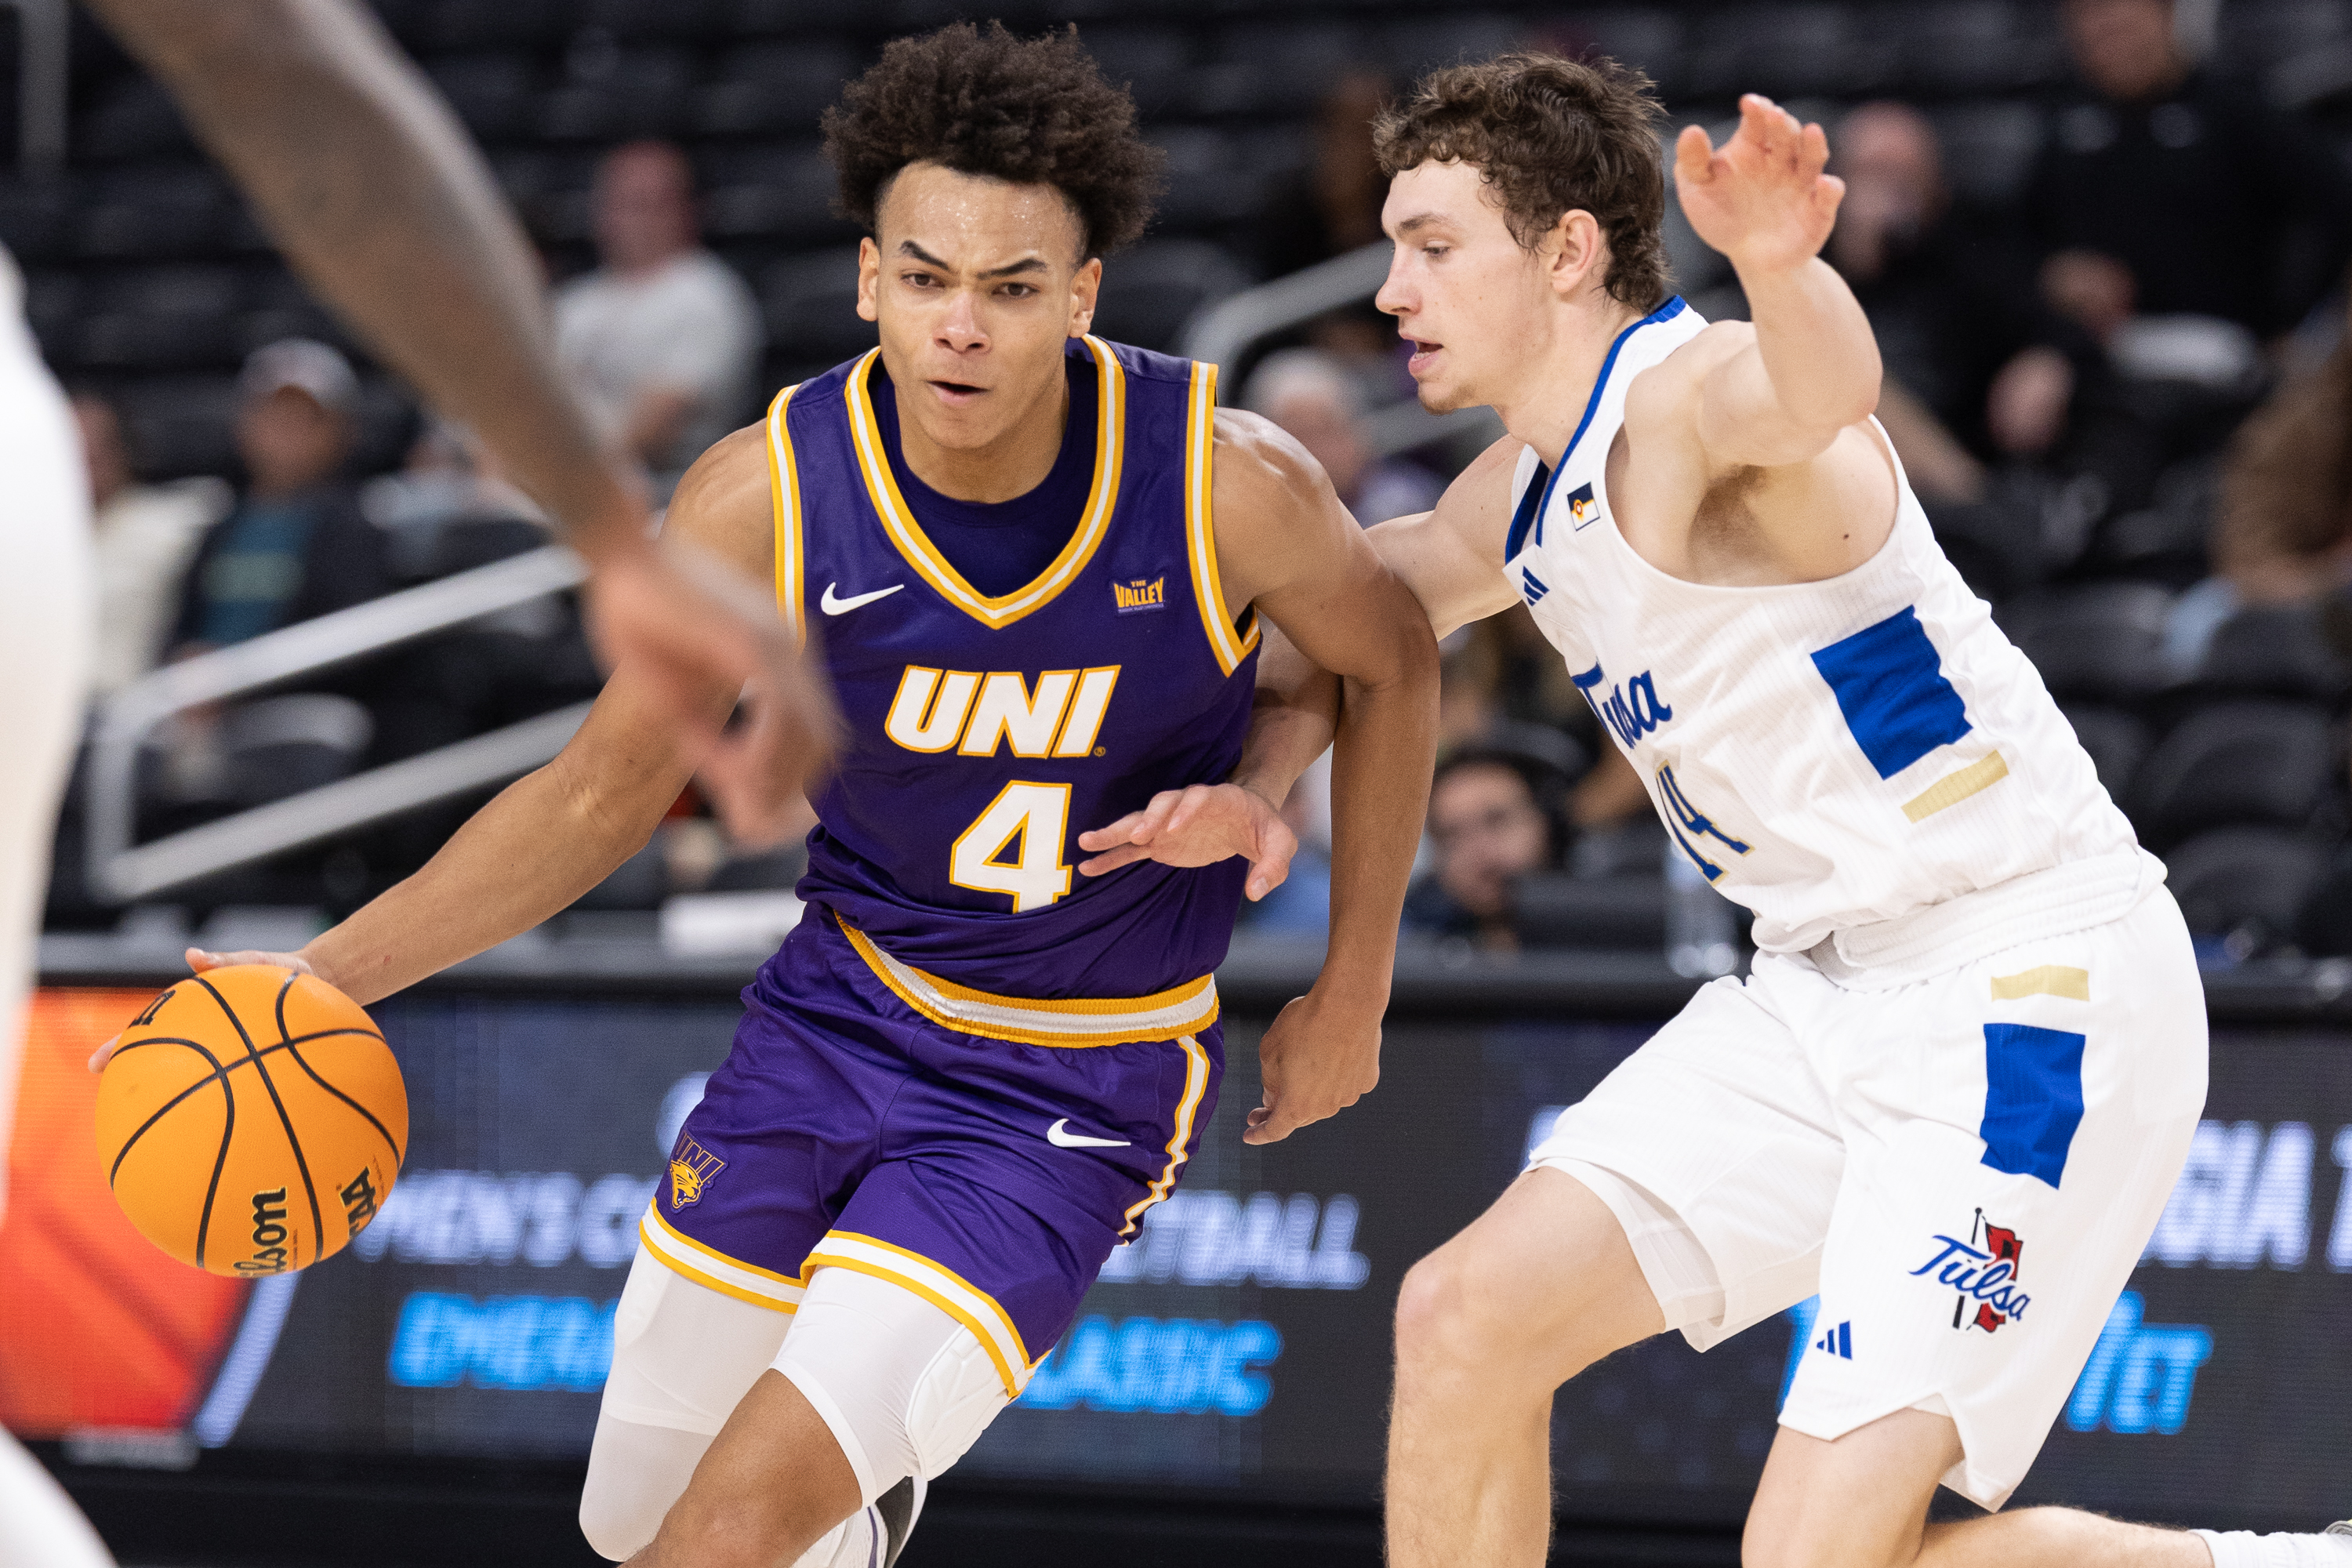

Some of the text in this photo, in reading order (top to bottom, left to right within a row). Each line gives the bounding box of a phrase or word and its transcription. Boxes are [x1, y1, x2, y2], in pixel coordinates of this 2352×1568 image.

[1114, 576, 1164, 608] VALLEY
[1131, 579, 1146, 588] THE
[884, 664, 1121, 760] UNI
[949, 779, 1073, 914] 4
[1655, 759, 1755, 887] 14
[1907, 1235, 2031, 1321] Tulsa
